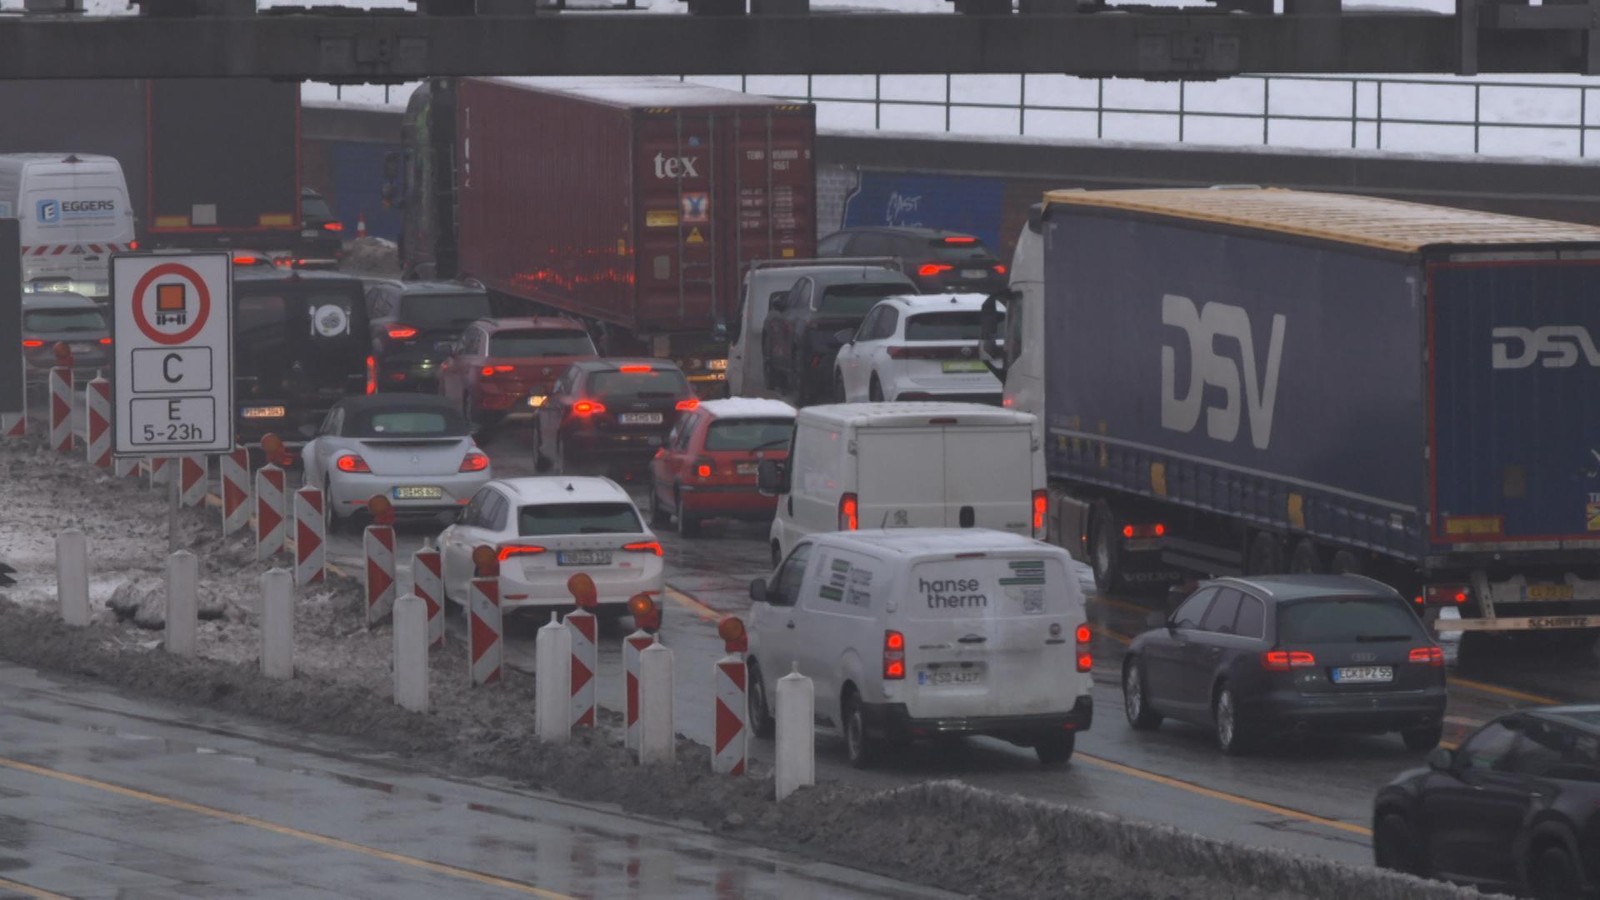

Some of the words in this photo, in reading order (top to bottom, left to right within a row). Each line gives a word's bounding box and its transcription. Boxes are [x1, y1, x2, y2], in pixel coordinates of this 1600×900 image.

[654, 152, 699, 179] tex
[62, 200, 115, 212] EGGERS
[163, 353, 184, 384] C
[1161, 293, 1287, 449] DSV
[168, 400, 182, 421] E
[144, 423, 203, 442] 5-23h
[919, 578, 979, 593] hanse
[927, 593, 988, 609] therm
